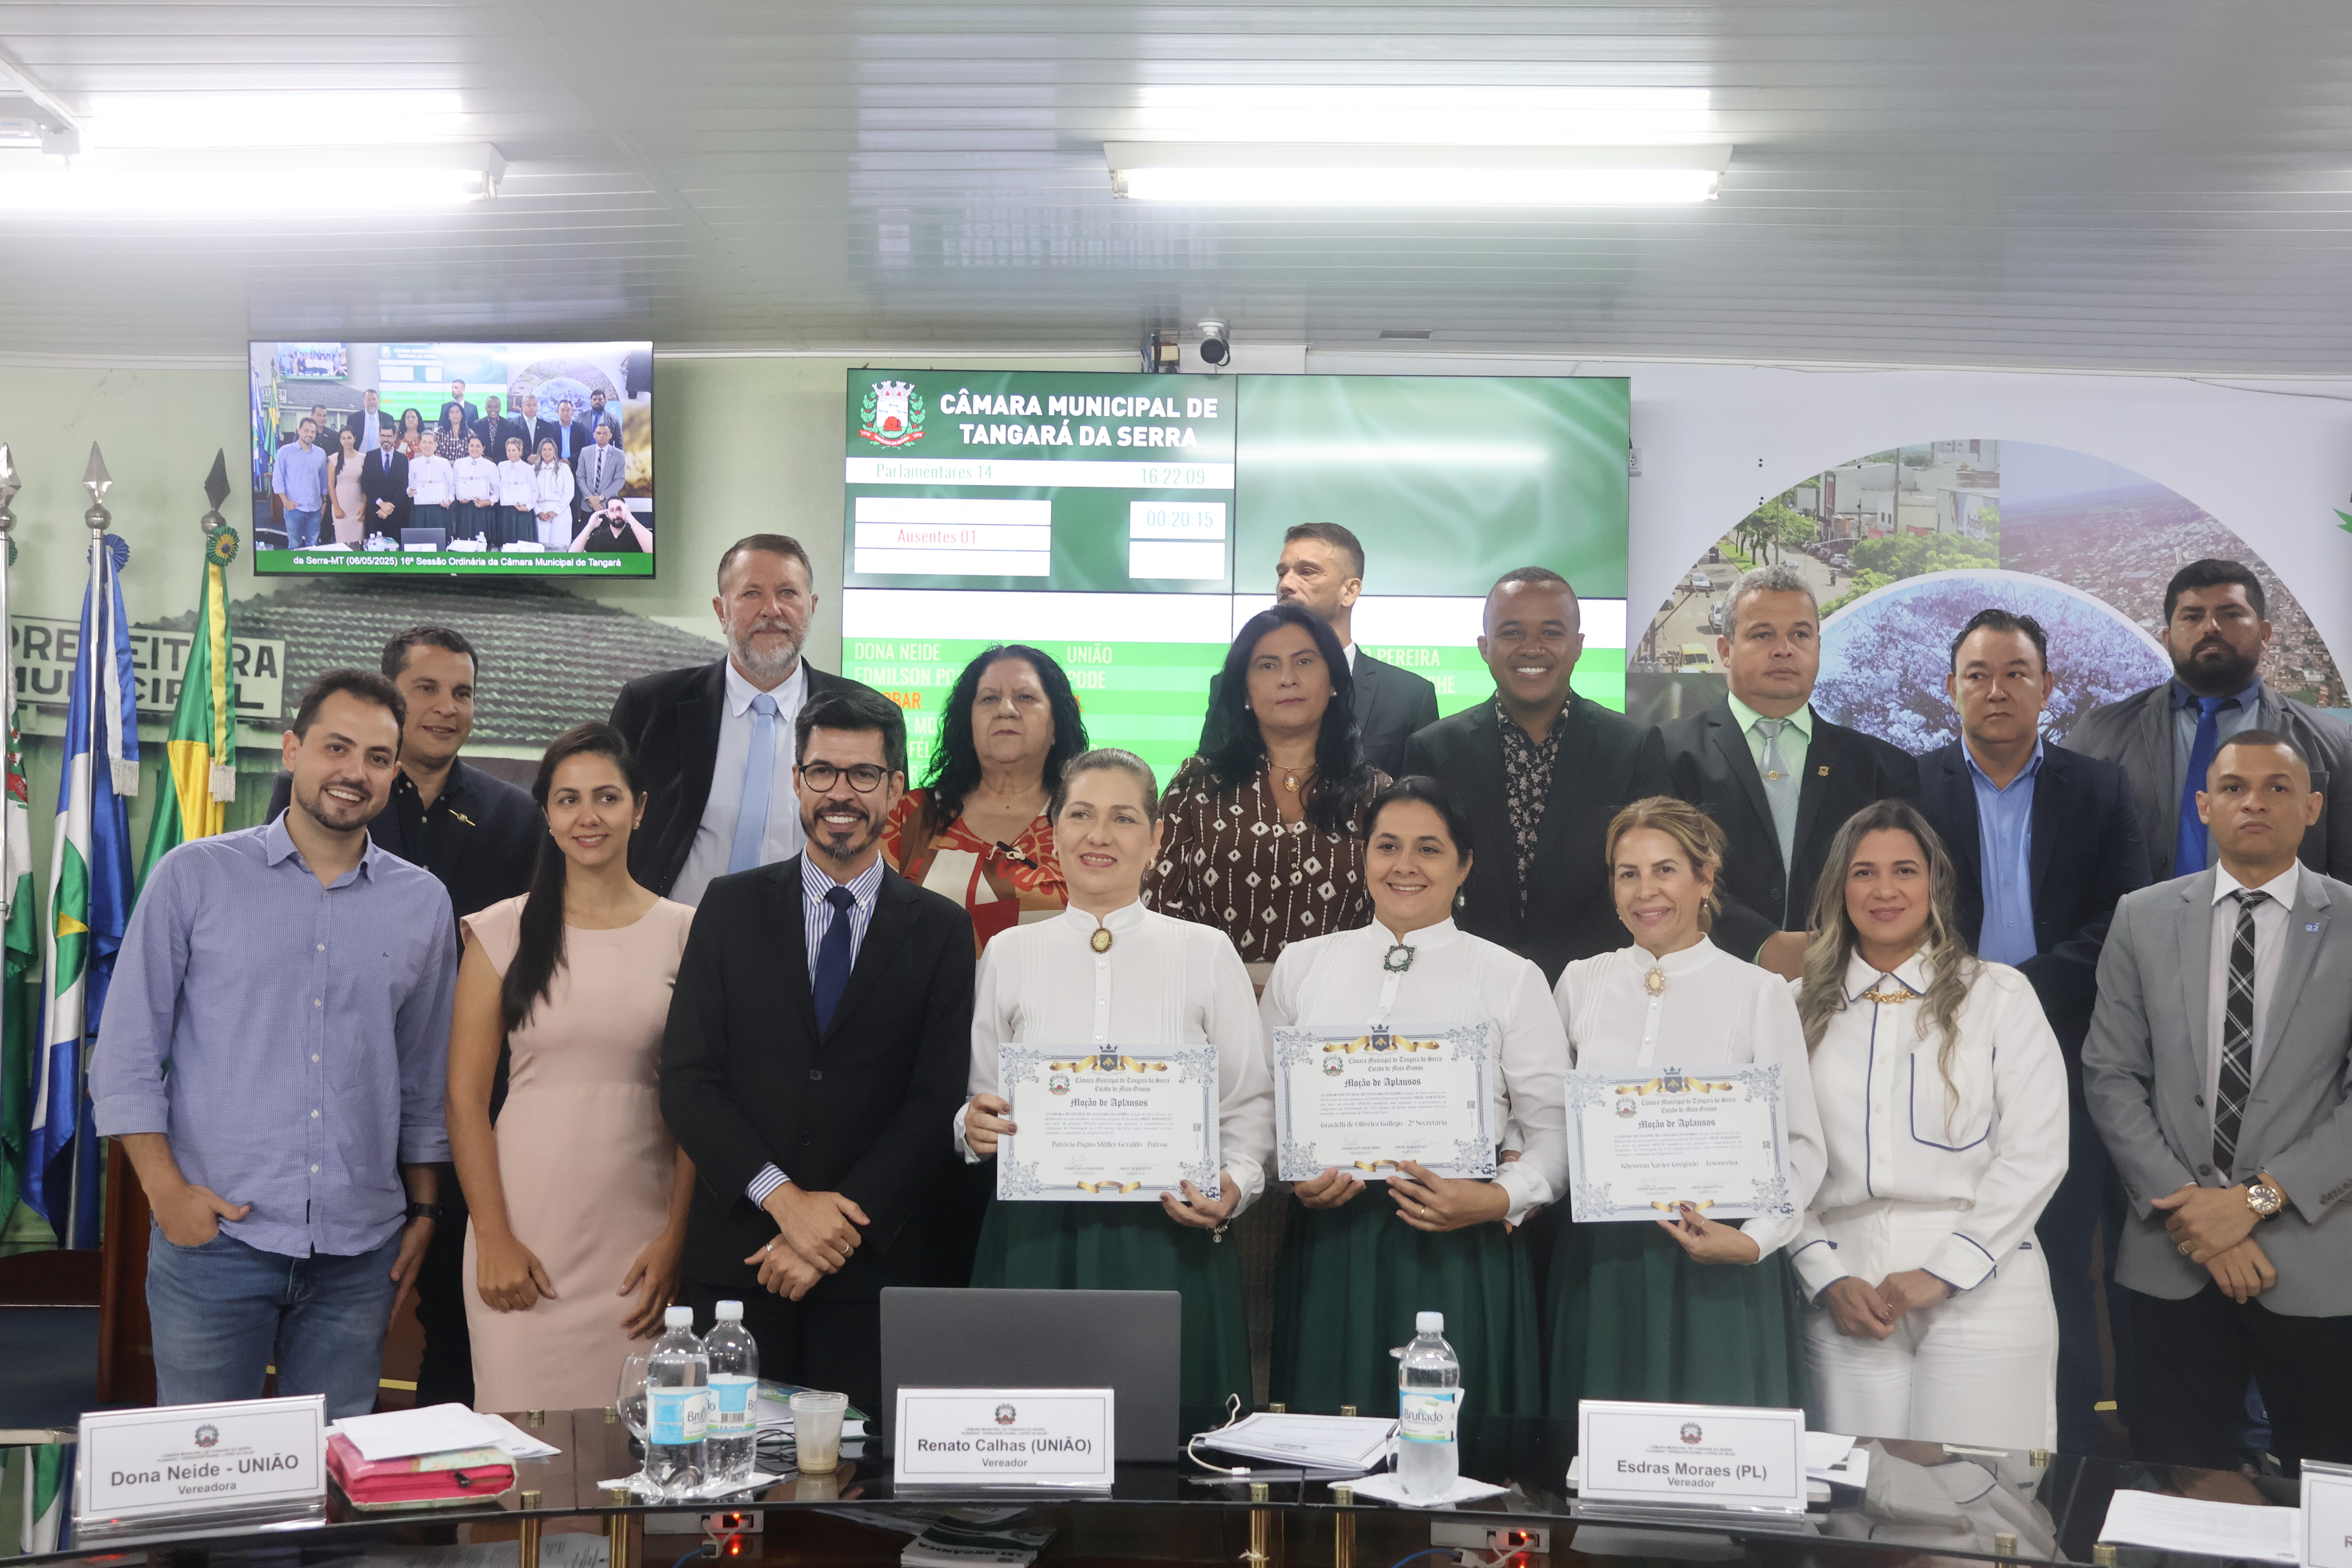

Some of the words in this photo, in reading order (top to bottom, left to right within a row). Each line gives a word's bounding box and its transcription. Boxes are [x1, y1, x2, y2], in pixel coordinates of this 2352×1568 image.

[940, 388, 1043, 416] CÂMARA
[1048, 396, 1181, 418] MUNICIPAL
[1187, 397, 1218, 418] DE
[959, 419, 1074, 445] TANGARÁ
[1079, 425, 1112, 446] DA
[1116, 426, 1198, 447] SERRA
[877, 463, 972, 479] Parlamentares
[978, 465, 992, 479] 14
[1141, 468, 1205, 485] 16:22:09
[1147, 511, 1213, 527] 00:20:15
[898, 529, 956, 543] Ausentes
[961, 530, 975, 544] 01
[306, 556, 344, 564] Serra-MT
[346, 556, 398, 566] (06/05/2025)
[448, 557, 486, 565] Ordinária
[488, 557, 499, 566] da
[500, 557, 533, 566] Câmara
[535, 557, 573, 568] Municipal
[575, 558, 586, 566] de
[588, 558, 621, 568] Tangará
[12, 625, 278, 678] REEITRA
[855, 642, 895, 660] DONA
[900, 643, 940, 661] NEIDE
[1067, 643, 1112, 664] UNIÃO
[1377, 648, 1440, 666] PEREIRA
[854, 667, 931, 685] EDMILSON
[1067, 670, 1106, 688] PODE
[1344, 1078, 1370, 1088] Moção
[1383, 1078, 1421, 1087] Aplausos
[1070, 1098, 1096, 1108] Moção
[1110, 1098, 1148, 1107] Aplausos
[1638, 1120, 1664, 1130] Moção
[1677, 1119, 1715, 1128] Aplausos
[1404, 1408, 1443, 1422] Brunado
[918, 1439, 970, 1452] Renato
[975, 1439, 1026, 1452] Calhas
[1031, 1436, 1092, 1454] (UNIÃO)
[111, 1468, 161, 1486] Dona
[167, 1463, 220, 1481] Neide
[238, 1453, 299, 1473] UNIÃO
[982, 1458, 1028, 1467] Vereador
[1617, 1459, 1670, 1475] Esdras
[1675, 1462, 1731, 1477] Moraes
[1736, 1465, 1767, 1481] (PL)
[178, 1481, 236, 1495] Vereadora
[1668, 1477, 1715, 1488] Vereador
